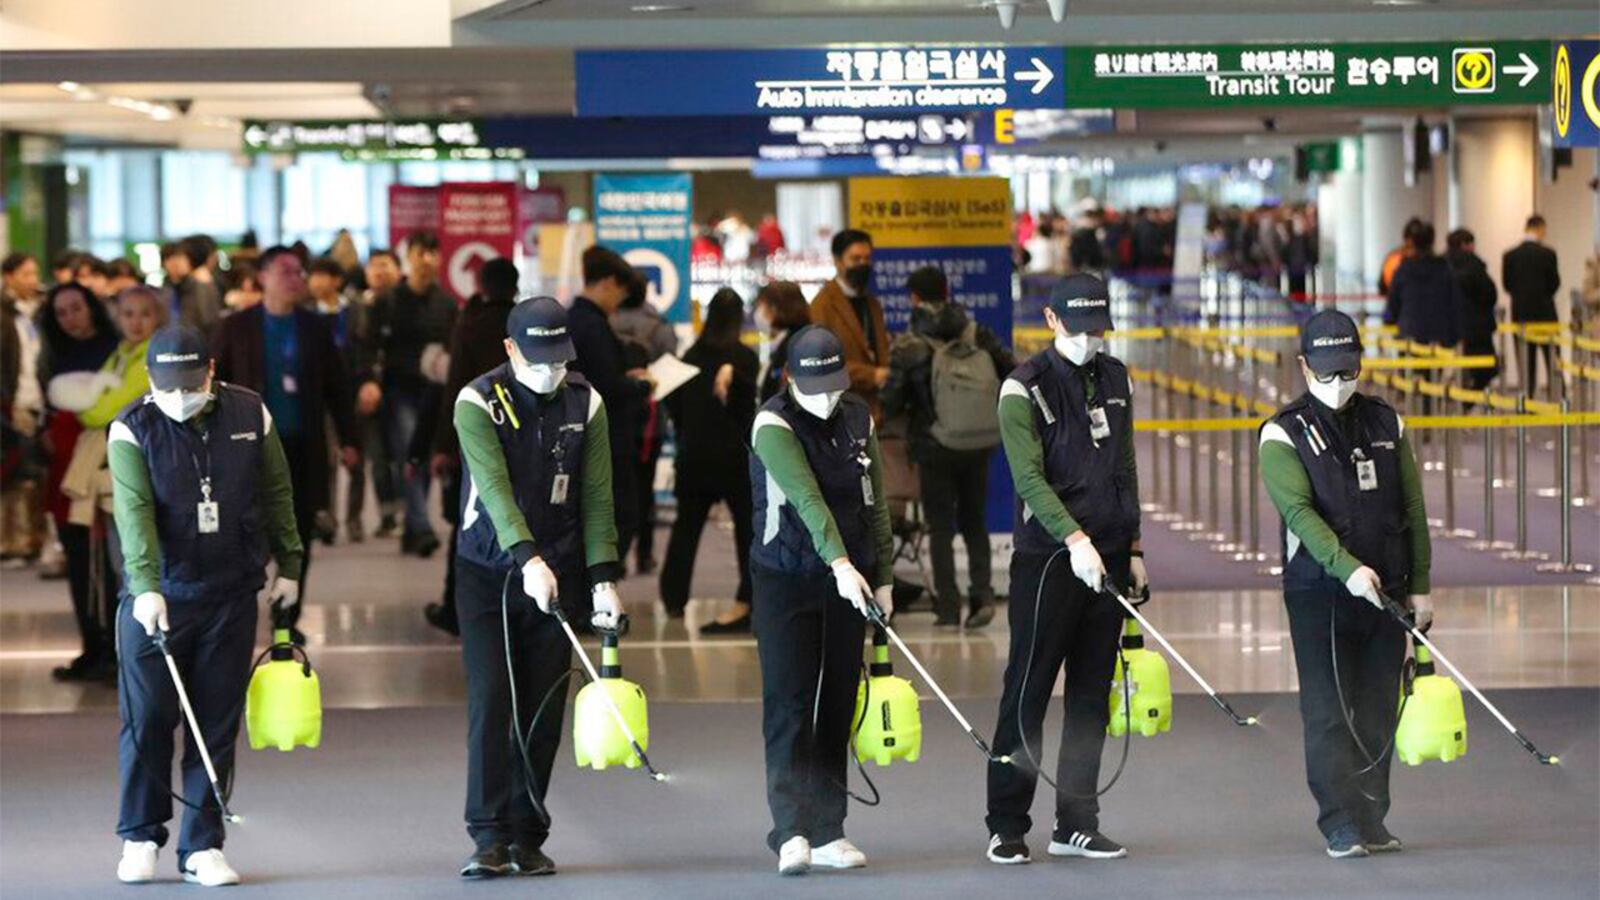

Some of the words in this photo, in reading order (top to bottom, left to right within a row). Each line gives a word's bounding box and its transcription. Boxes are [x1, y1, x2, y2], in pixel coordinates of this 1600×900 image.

[827, 49, 1005, 80] 자동출입국심사
[1348, 56, 1439, 86] 환승투어
[757, 86, 803, 107] Auto
[915, 84, 1006, 106] clearance
[1206, 75, 1279, 97] Transit
[1285, 73, 1335, 96] Tour
[995, 109, 1014, 143] E
[860, 201, 960, 217] 자동출입국심사
